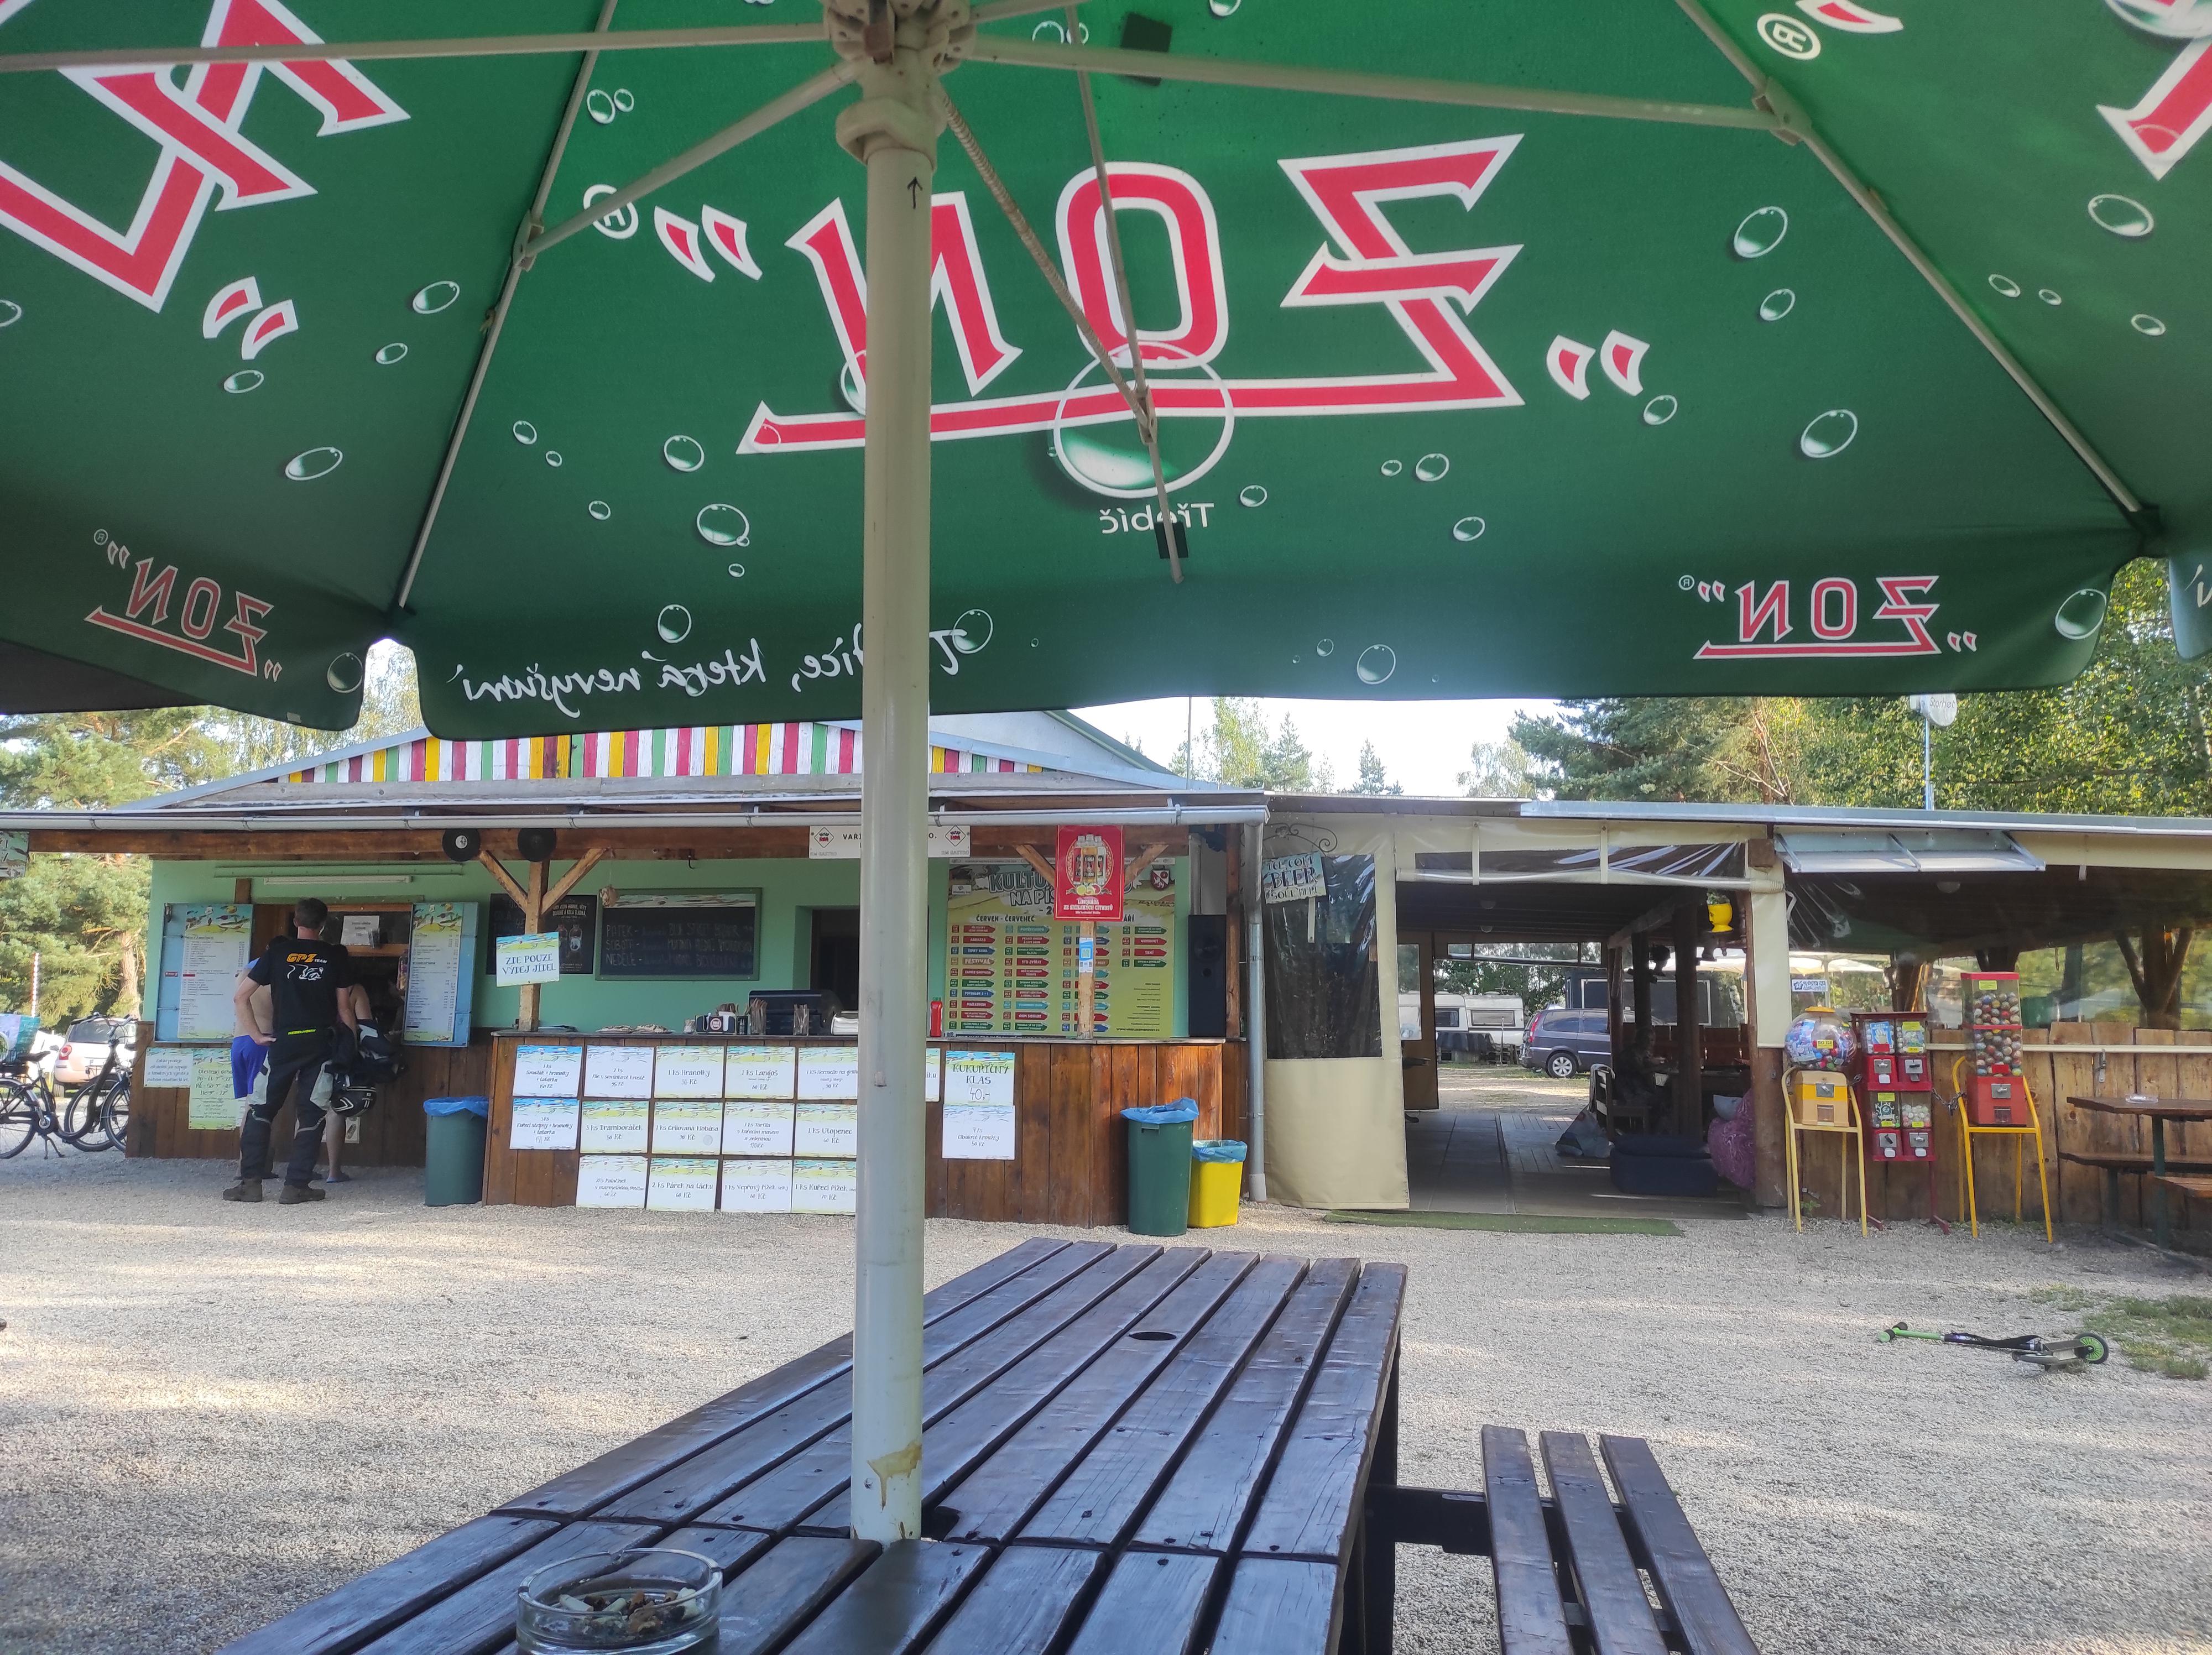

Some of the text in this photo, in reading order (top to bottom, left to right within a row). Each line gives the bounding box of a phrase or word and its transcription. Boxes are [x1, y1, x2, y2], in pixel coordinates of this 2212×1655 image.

[989, 871, 1052, 893] KULTU
[1010, 891, 1032, 906] NA
[286, 953, 317, 963] GPZ
[505, 954, 553, 965] ZDE POUZE
[502, 965, 529, 975] VÝDEJ
[533, 963, 556, 972] JÍDEL
[682, 1069, 710, 1078] Hranolky
[755, 1069, 778, 1078] Langoš
[966, 1076, 991, 1084] KLAS
[822, 1128, 852, 1137] Utopenec
[737, 1184, 760, 1193] Vepřový
